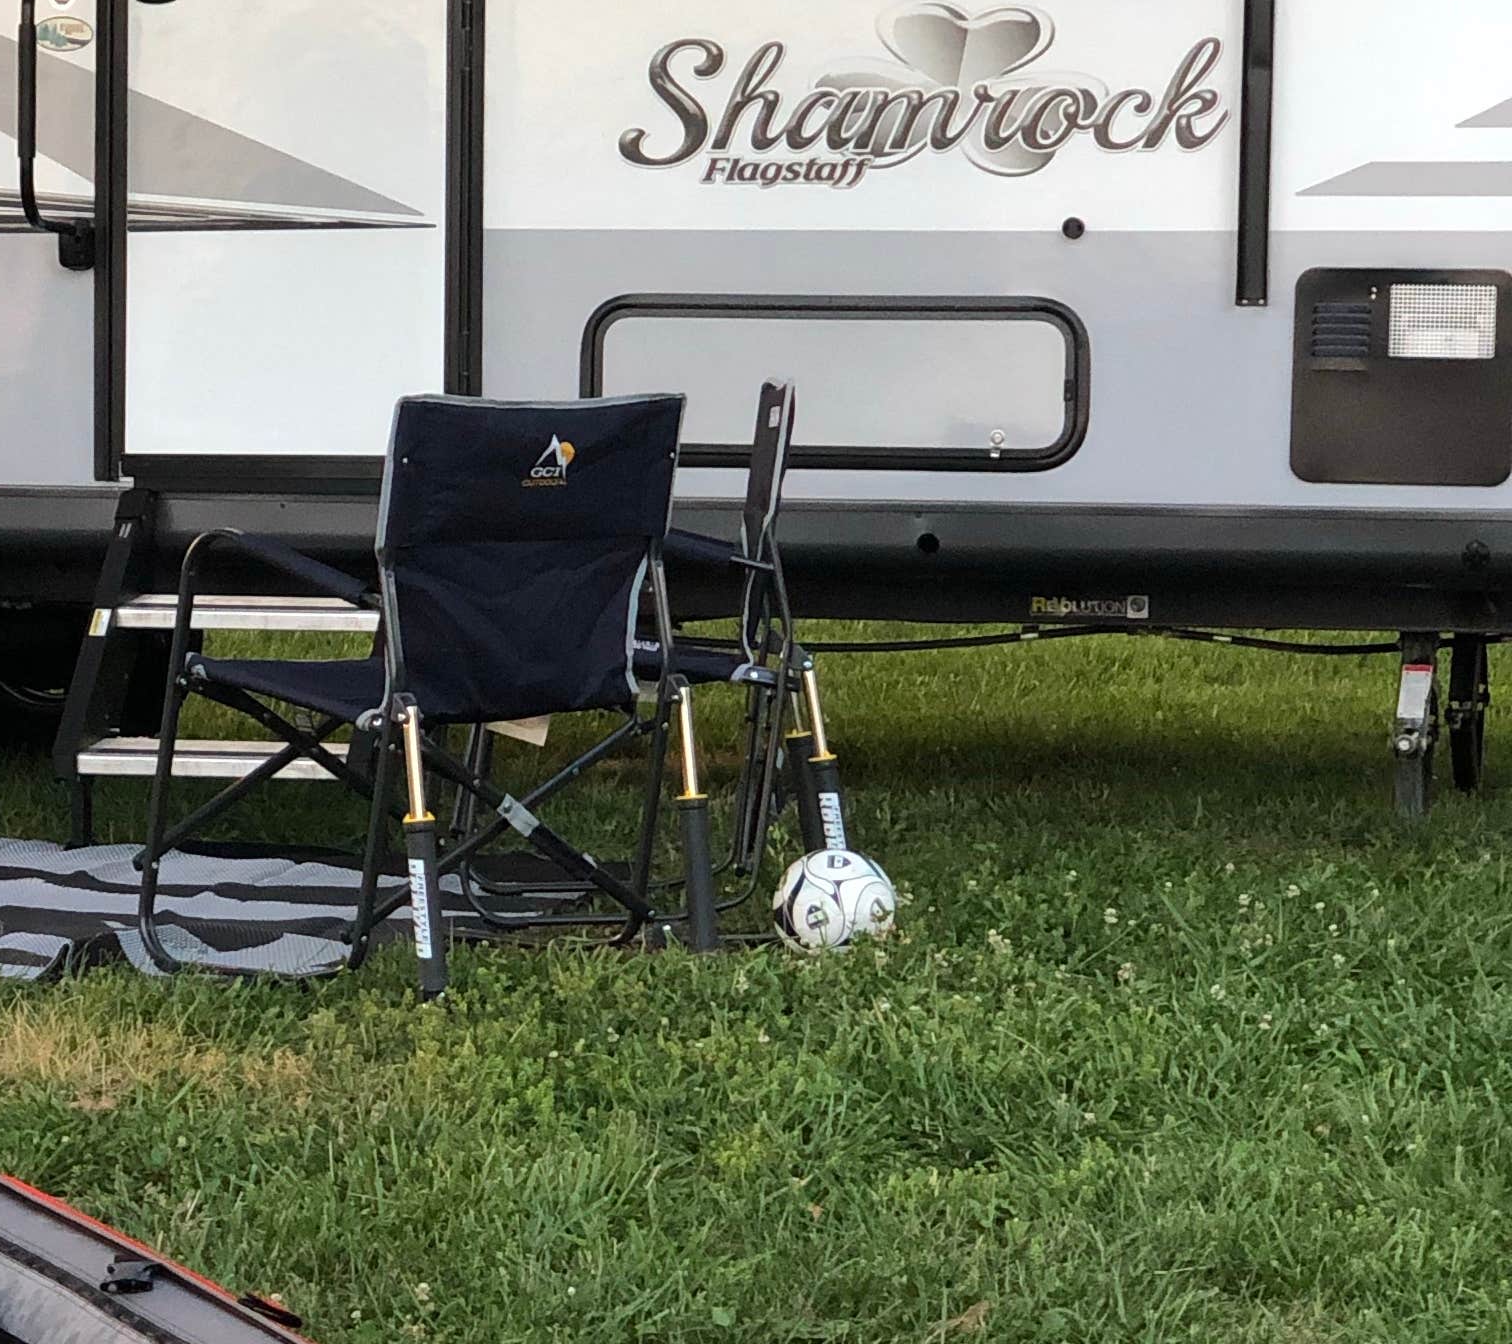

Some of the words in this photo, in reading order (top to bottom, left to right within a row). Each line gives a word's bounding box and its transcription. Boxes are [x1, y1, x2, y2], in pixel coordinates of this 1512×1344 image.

[619, 37, 1229, 165] Shamrock
[703, 157, 872, 187] Flagstaff
[530, 466, 562, 478] GCI
